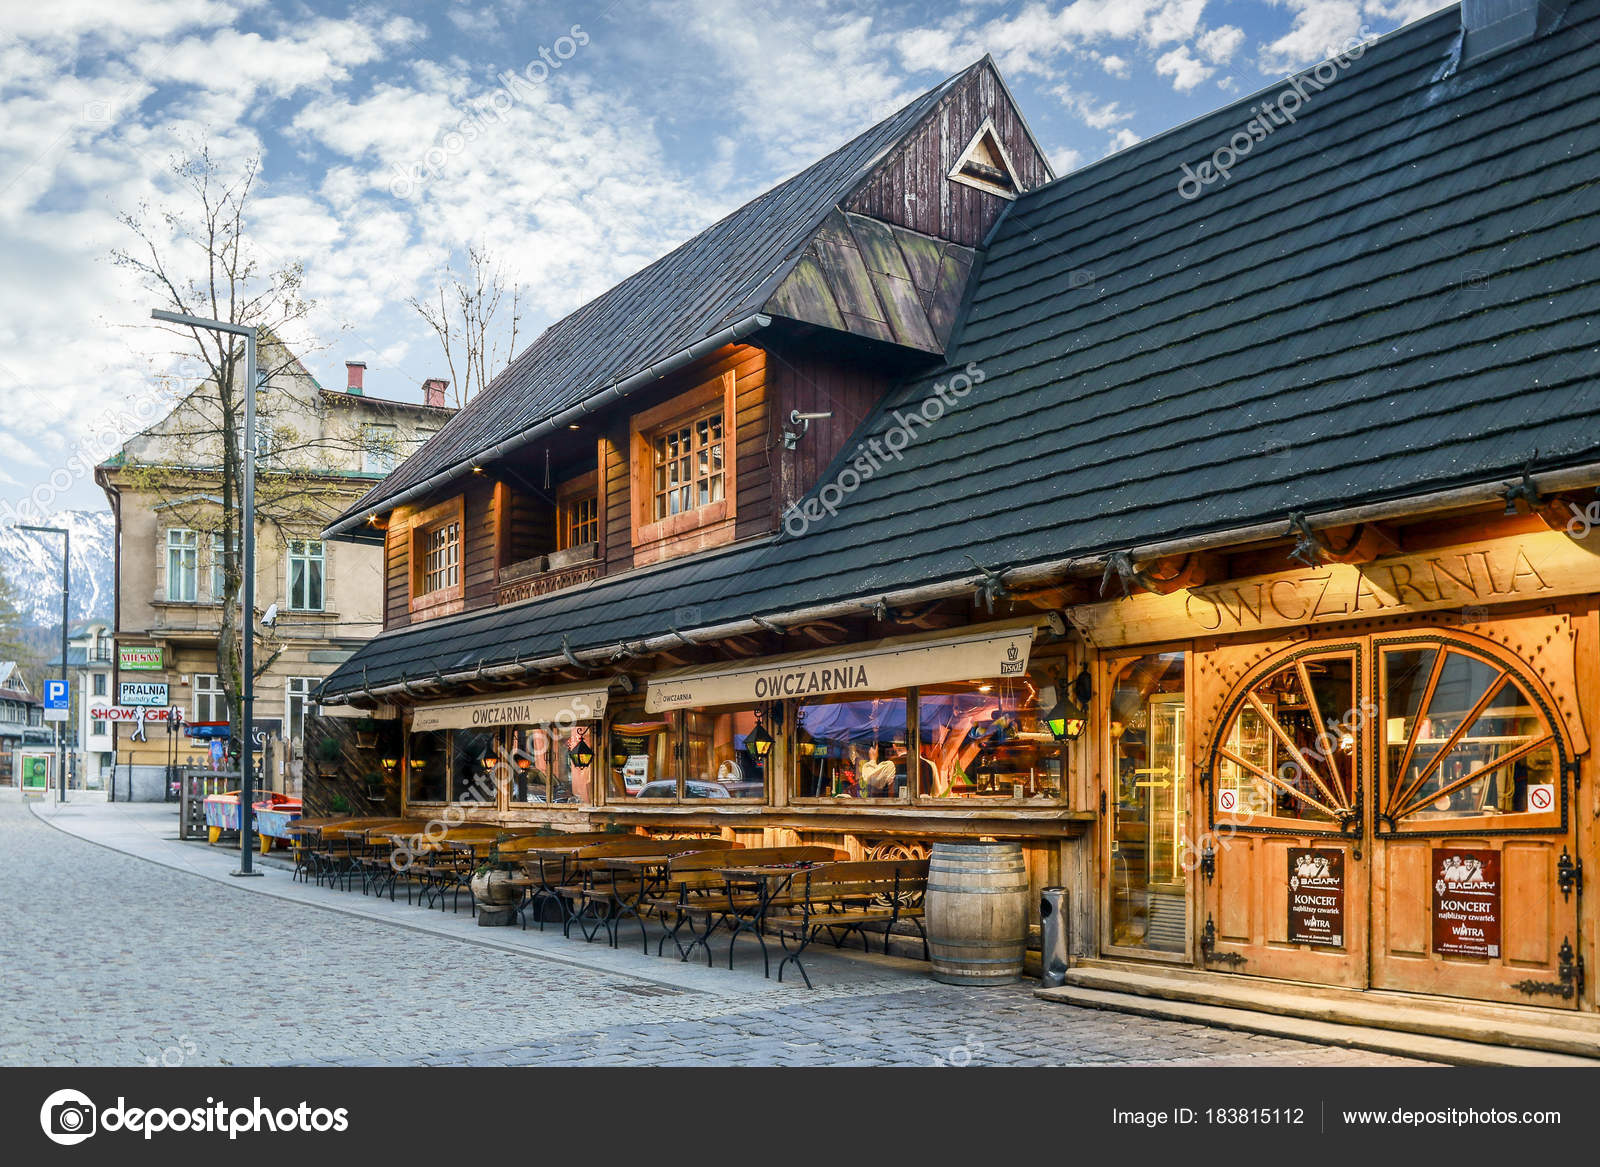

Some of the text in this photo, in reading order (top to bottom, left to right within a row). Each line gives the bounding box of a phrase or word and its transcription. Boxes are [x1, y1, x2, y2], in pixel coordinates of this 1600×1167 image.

[1186, 545, 1553, 631] OWCZARNIA
[755, 665, 869, 698] OWCZARNIA
[49, 682, 64, 700] P
[122, 684, 166, 696] PRALNIA
[90, 708, 183, 721] SHOW GIRS
[473, 704, 531, 725] OWCZARNIA
[1294, 894, 1337, 907] KONCERT
[1441, 900, 1492, 914] KONCERT
